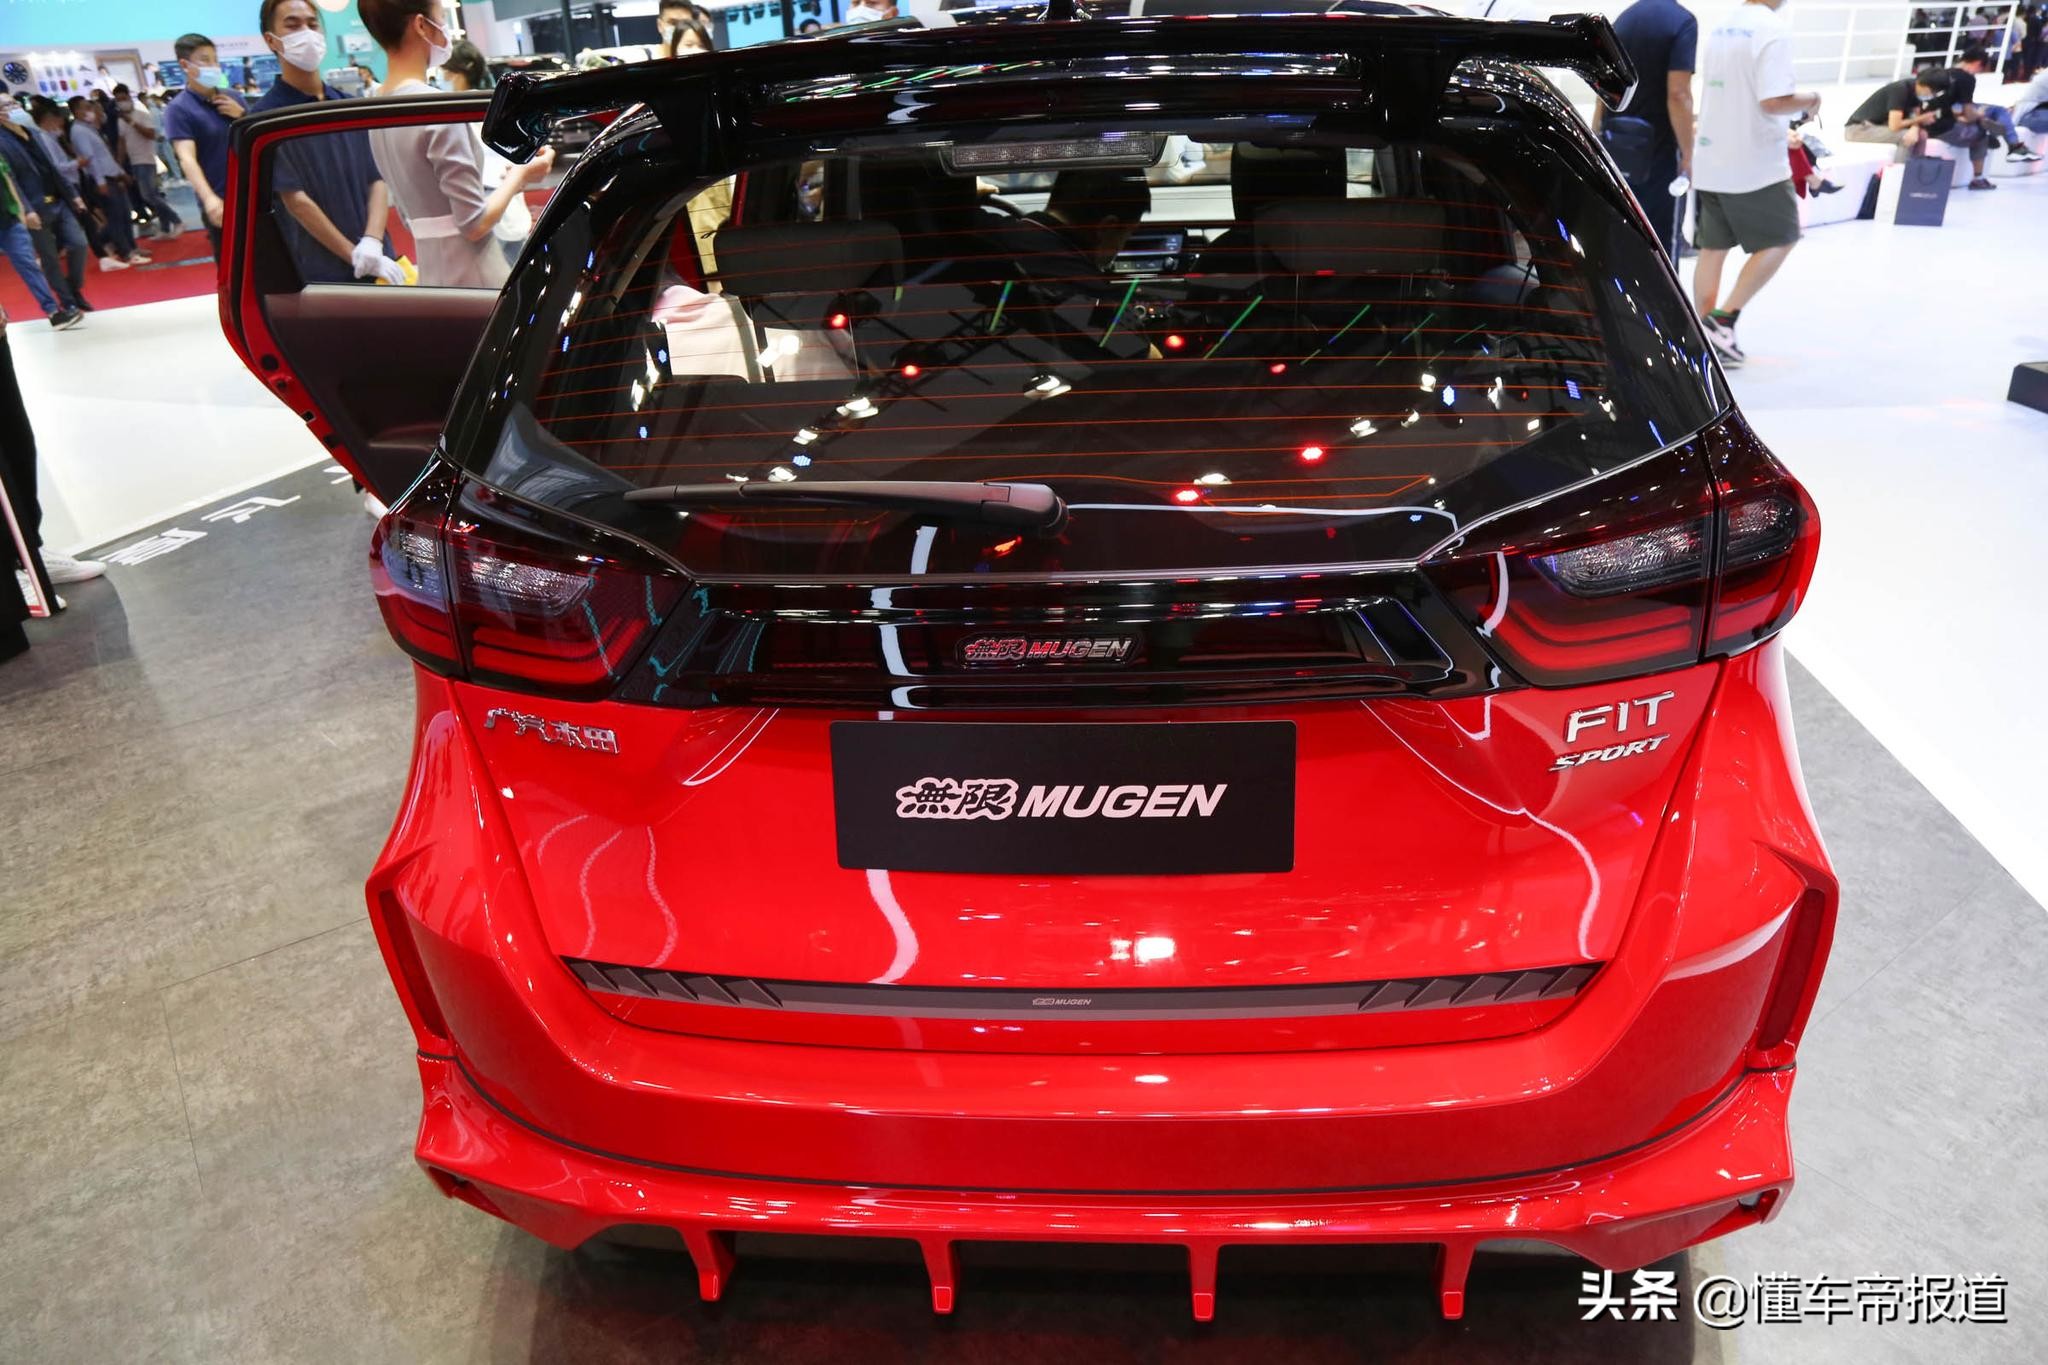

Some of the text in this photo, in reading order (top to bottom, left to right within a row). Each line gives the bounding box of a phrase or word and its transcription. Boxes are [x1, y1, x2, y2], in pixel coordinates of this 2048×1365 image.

[1026, 639, 1132, 659] MUGEN
[1565, 690, 1675, 743] FIT
[1549, 734, 1670, 771] SPORT
[1017, 784, 1228, 817] MUGEN
[1054, 998, 1092, 1006] MUGEN
